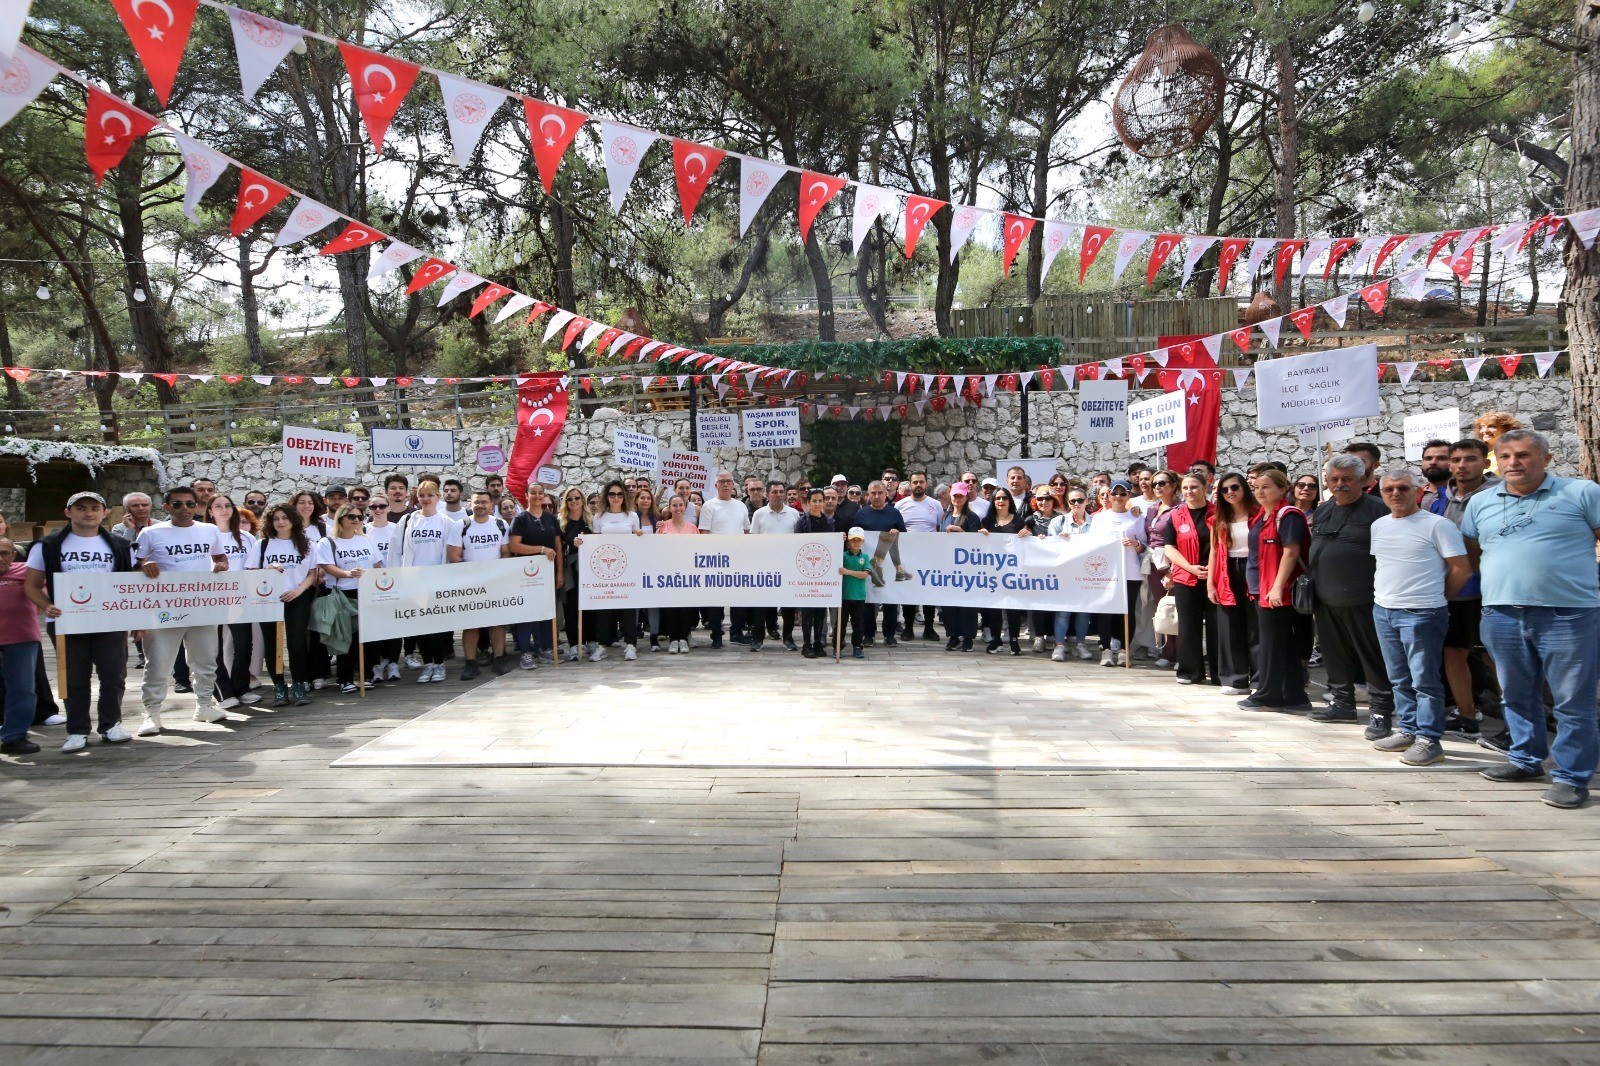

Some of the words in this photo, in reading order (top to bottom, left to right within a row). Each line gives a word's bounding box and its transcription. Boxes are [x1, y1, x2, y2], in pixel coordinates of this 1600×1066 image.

[1287, 366, 1329, 378] BAYRAKLI
[1281, 385, 1299, 393] İLÇE
[1309, 379, 1340, 390] SAĞLIK
[1081, 397, 1124, 412] OBEZİTEYE
[1281, 395, 1341, 409] MÜDÜRLÜĞÜ
[746, 411, 773, 420] YAŞAM
[1131, 407, 1153, 420] HER
[1157, 399, 1181, 413] GÜN
[755, 420, 789, 429] SPOR,
[1090, 417, 1114, 428] HAYIR
[1138, 421, 1151, 432] 10
[1155, 414, 1175, 428] BİN
[616, 431, 639, 440] YAŞAM
[640, 436, 656, 444] BOYU
[700, 431, 732, 439] SAĞLIKLI
[747, 430, 775, 438] YAŞAM
[1139, 429, 1174, 445] ADIM!
[286, 437, 354, 455] OBEZİTEYE
[623, 440, 650, 452] SPOR,
[750, 437, 794, 448] SAĞLIK!
[617, 448, 640, 457] YAŞAM
[672, 452, 700, 462] İZMİR
[299, 455, 341, 469] HAYIR!
[620, 456, 655, 469] SAĞLIK!
[662, 460, 708, 473] YÜRÜYOR,
[661, 478, 705, 489] KOYOR
[694, 552, 730, 568] İZMİR
[954, 547, 1018, 572] Dünya
[642, 572, 654, 588] İL
[657, 572, 701, 588] SAĞLIK
[705, 571, 782, 588] MÜDÜRLÜĞÜ
[917, 569, 998, 593] Yürüyüş
[1001, 572, 1059, 591] Günü
[435, 586, 487, 599] BORNOVA
[101, 597, 161, 611] SAĞLIĞA
[394, 608, 416, 620] İLÇE
[419, 605, 456, 617] SAĞLIK
[458, 596, 525, 612] MÜDÜRLÜĞÜ
